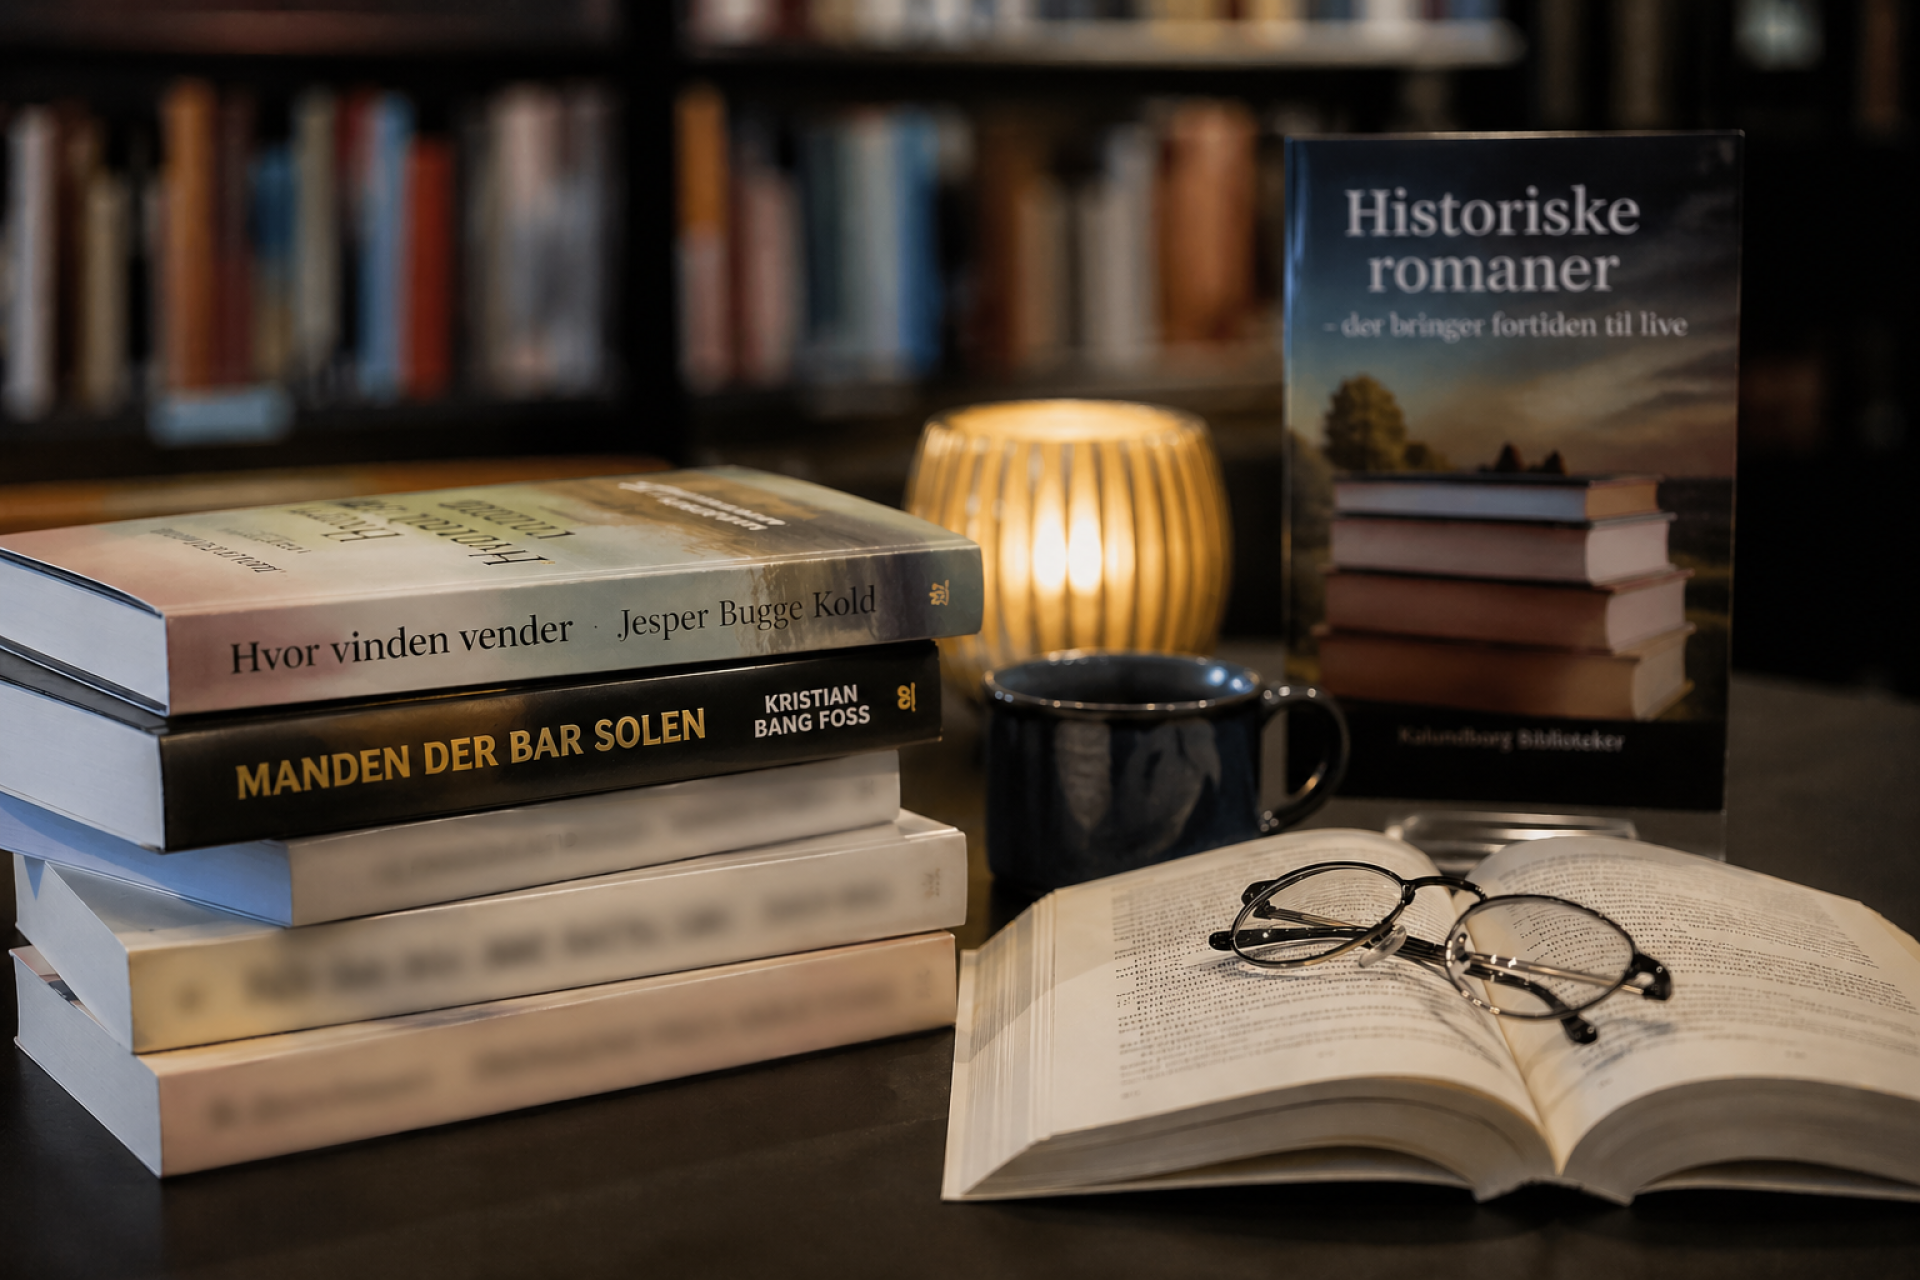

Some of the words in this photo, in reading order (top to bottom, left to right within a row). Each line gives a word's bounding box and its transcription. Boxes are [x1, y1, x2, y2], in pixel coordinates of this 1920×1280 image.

[1344, 184, 1640, 237] Historiske
[1368, 254, 1619, 293] romaner
[1341, 311, 1385, 337] der
[1390, 311, 1484, 343] bringer
[1491, 311, 1598, 337] fortiden
[1605, 311, 1632, 336] til
[1640, 311, 1689, 337] live
[231, 642, 320, 674] Hvor
[330, 627, 449, 663] vinden
[459, 614, 574, 651] vender
[617, 607, 710, 642] Jesper
[718, 596, 804, 632] Bugge
[813, 585, 876, 620] Kold
[765, 685, 858, 713] KRISTIAN
[755, 715, 812, 738] BANG
[819, 706, 870, 729] FOSS
[237, 745, 410, 799] MANDEN
[425, 735, 499, 775] DER
[510, 723, 582, 764] BAR
[594, 708, 706, 751] SOLEN
[1518, 728, 1626, 753] Biblioteker
